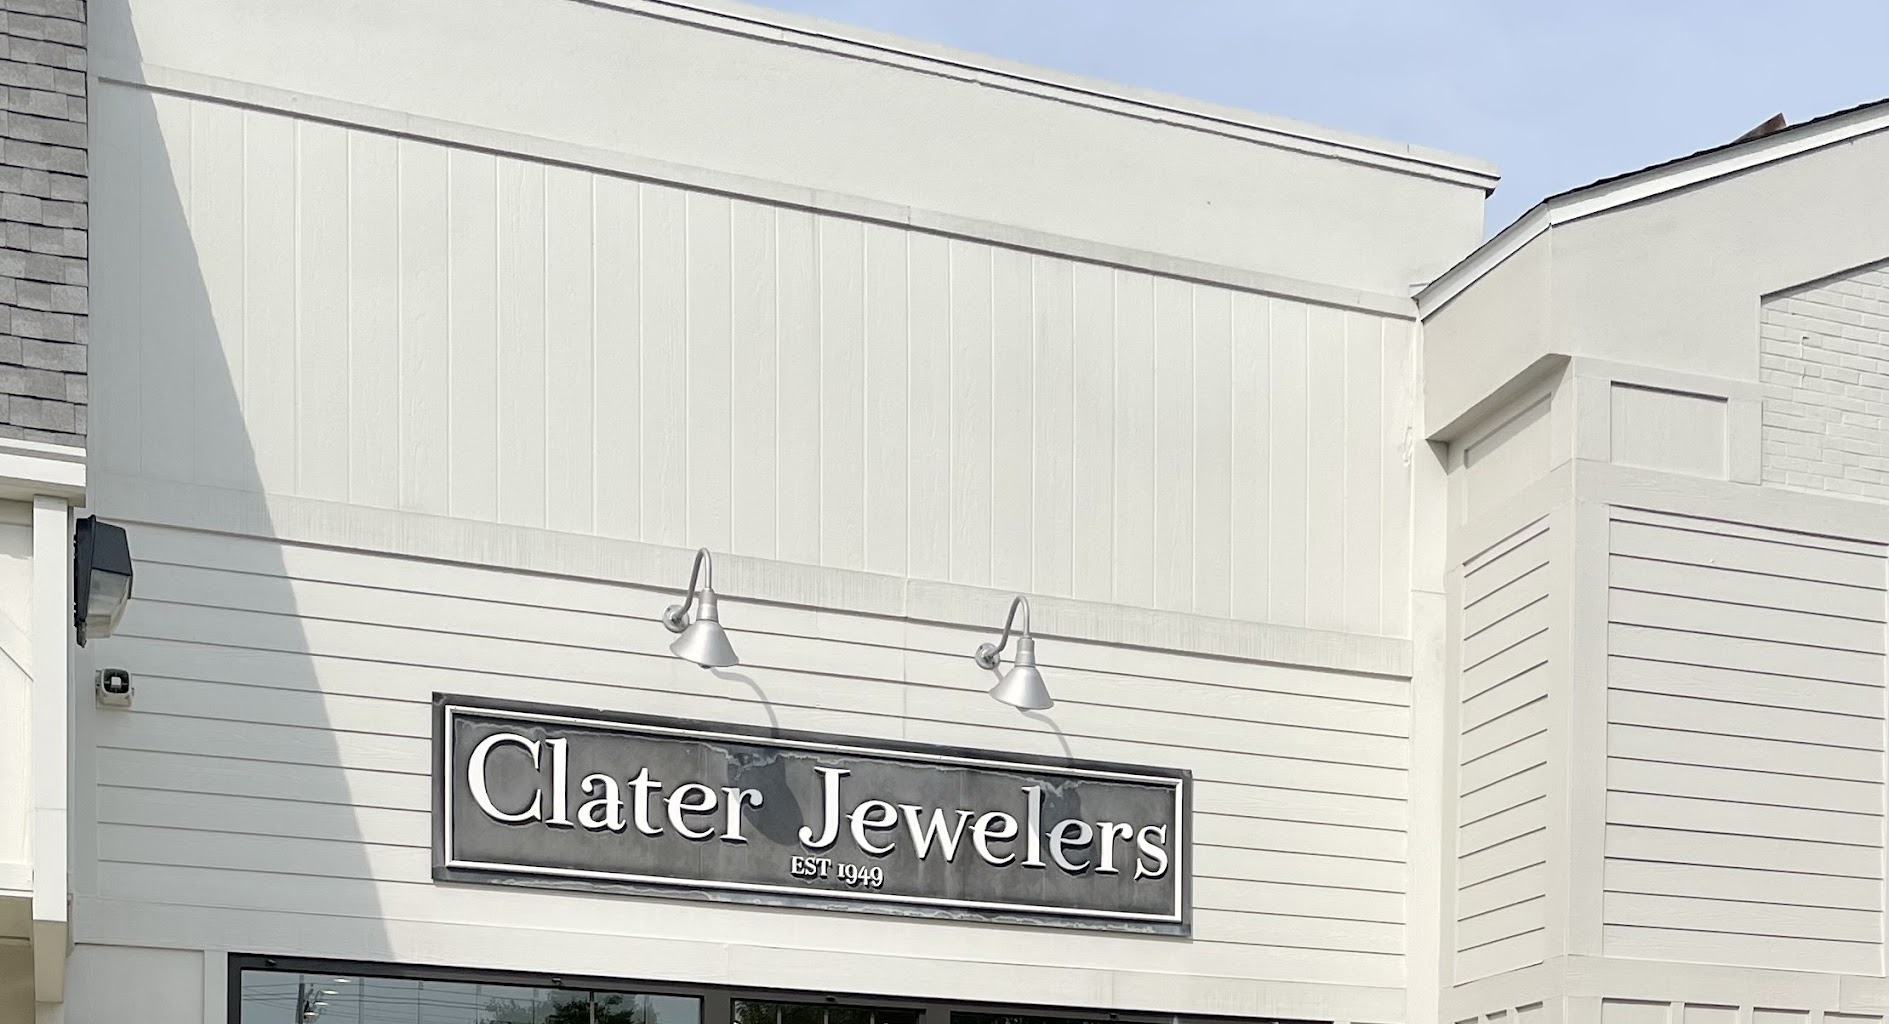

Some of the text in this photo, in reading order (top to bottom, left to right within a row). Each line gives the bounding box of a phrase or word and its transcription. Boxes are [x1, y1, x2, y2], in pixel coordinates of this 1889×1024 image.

[466, 731, 1169, 881] Clater Jewelers
[791, 855, 884, 888] EST 1949
